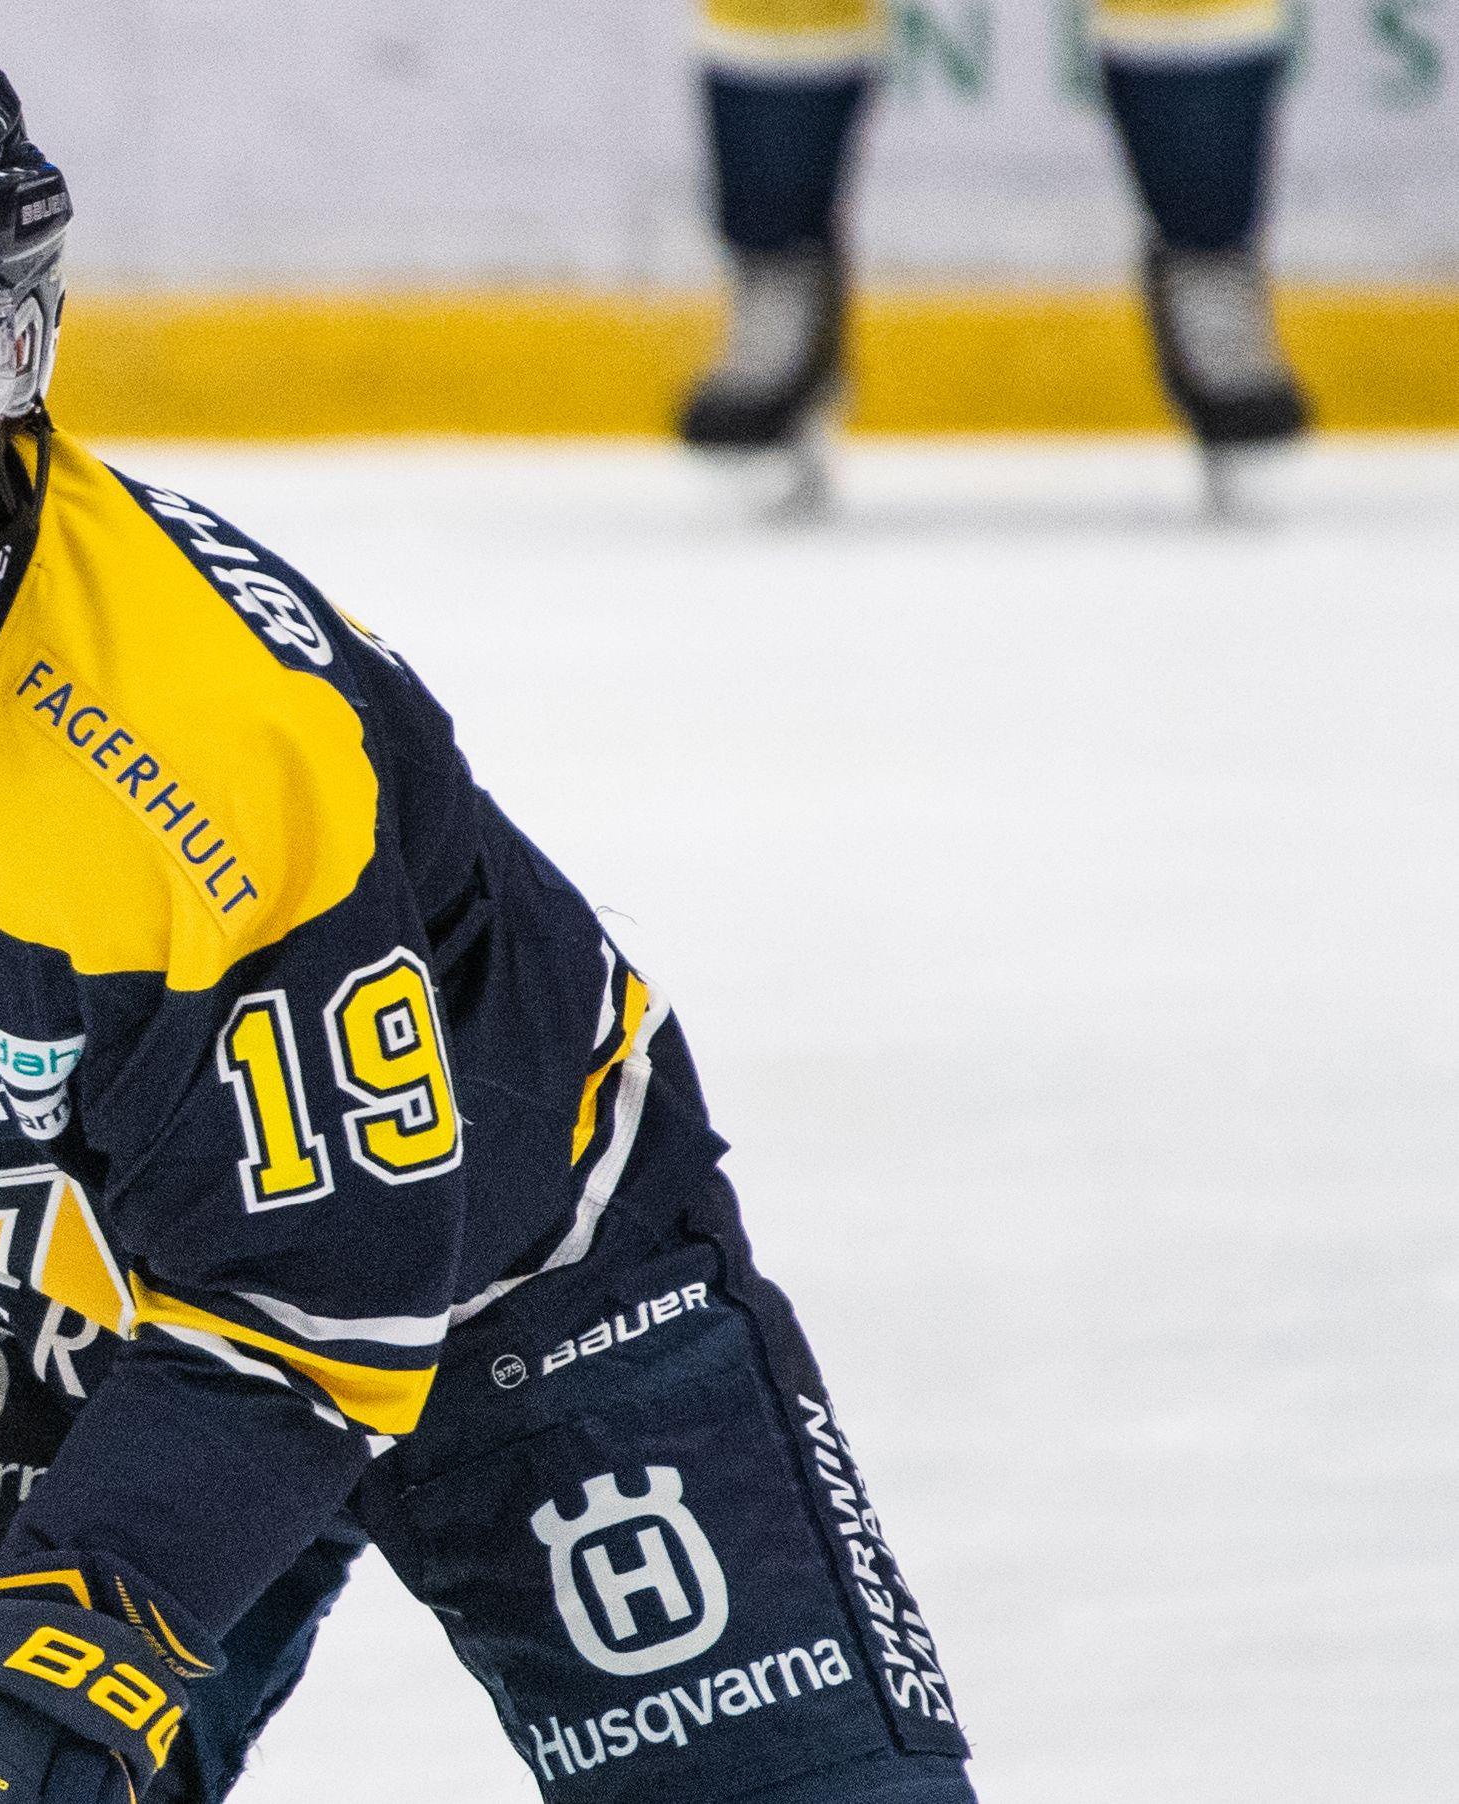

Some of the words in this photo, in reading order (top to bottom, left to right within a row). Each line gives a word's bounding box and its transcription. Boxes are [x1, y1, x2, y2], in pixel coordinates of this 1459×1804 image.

[15, 658, 259, 915] FAGERHULT
[216, 945, 464, 1214] 19
[542, 1281, 709, 1376] BAUER
[797, 1394, 931, 1717] SHERWIN
[530, 1636, 853, 1781] Husqvarna
